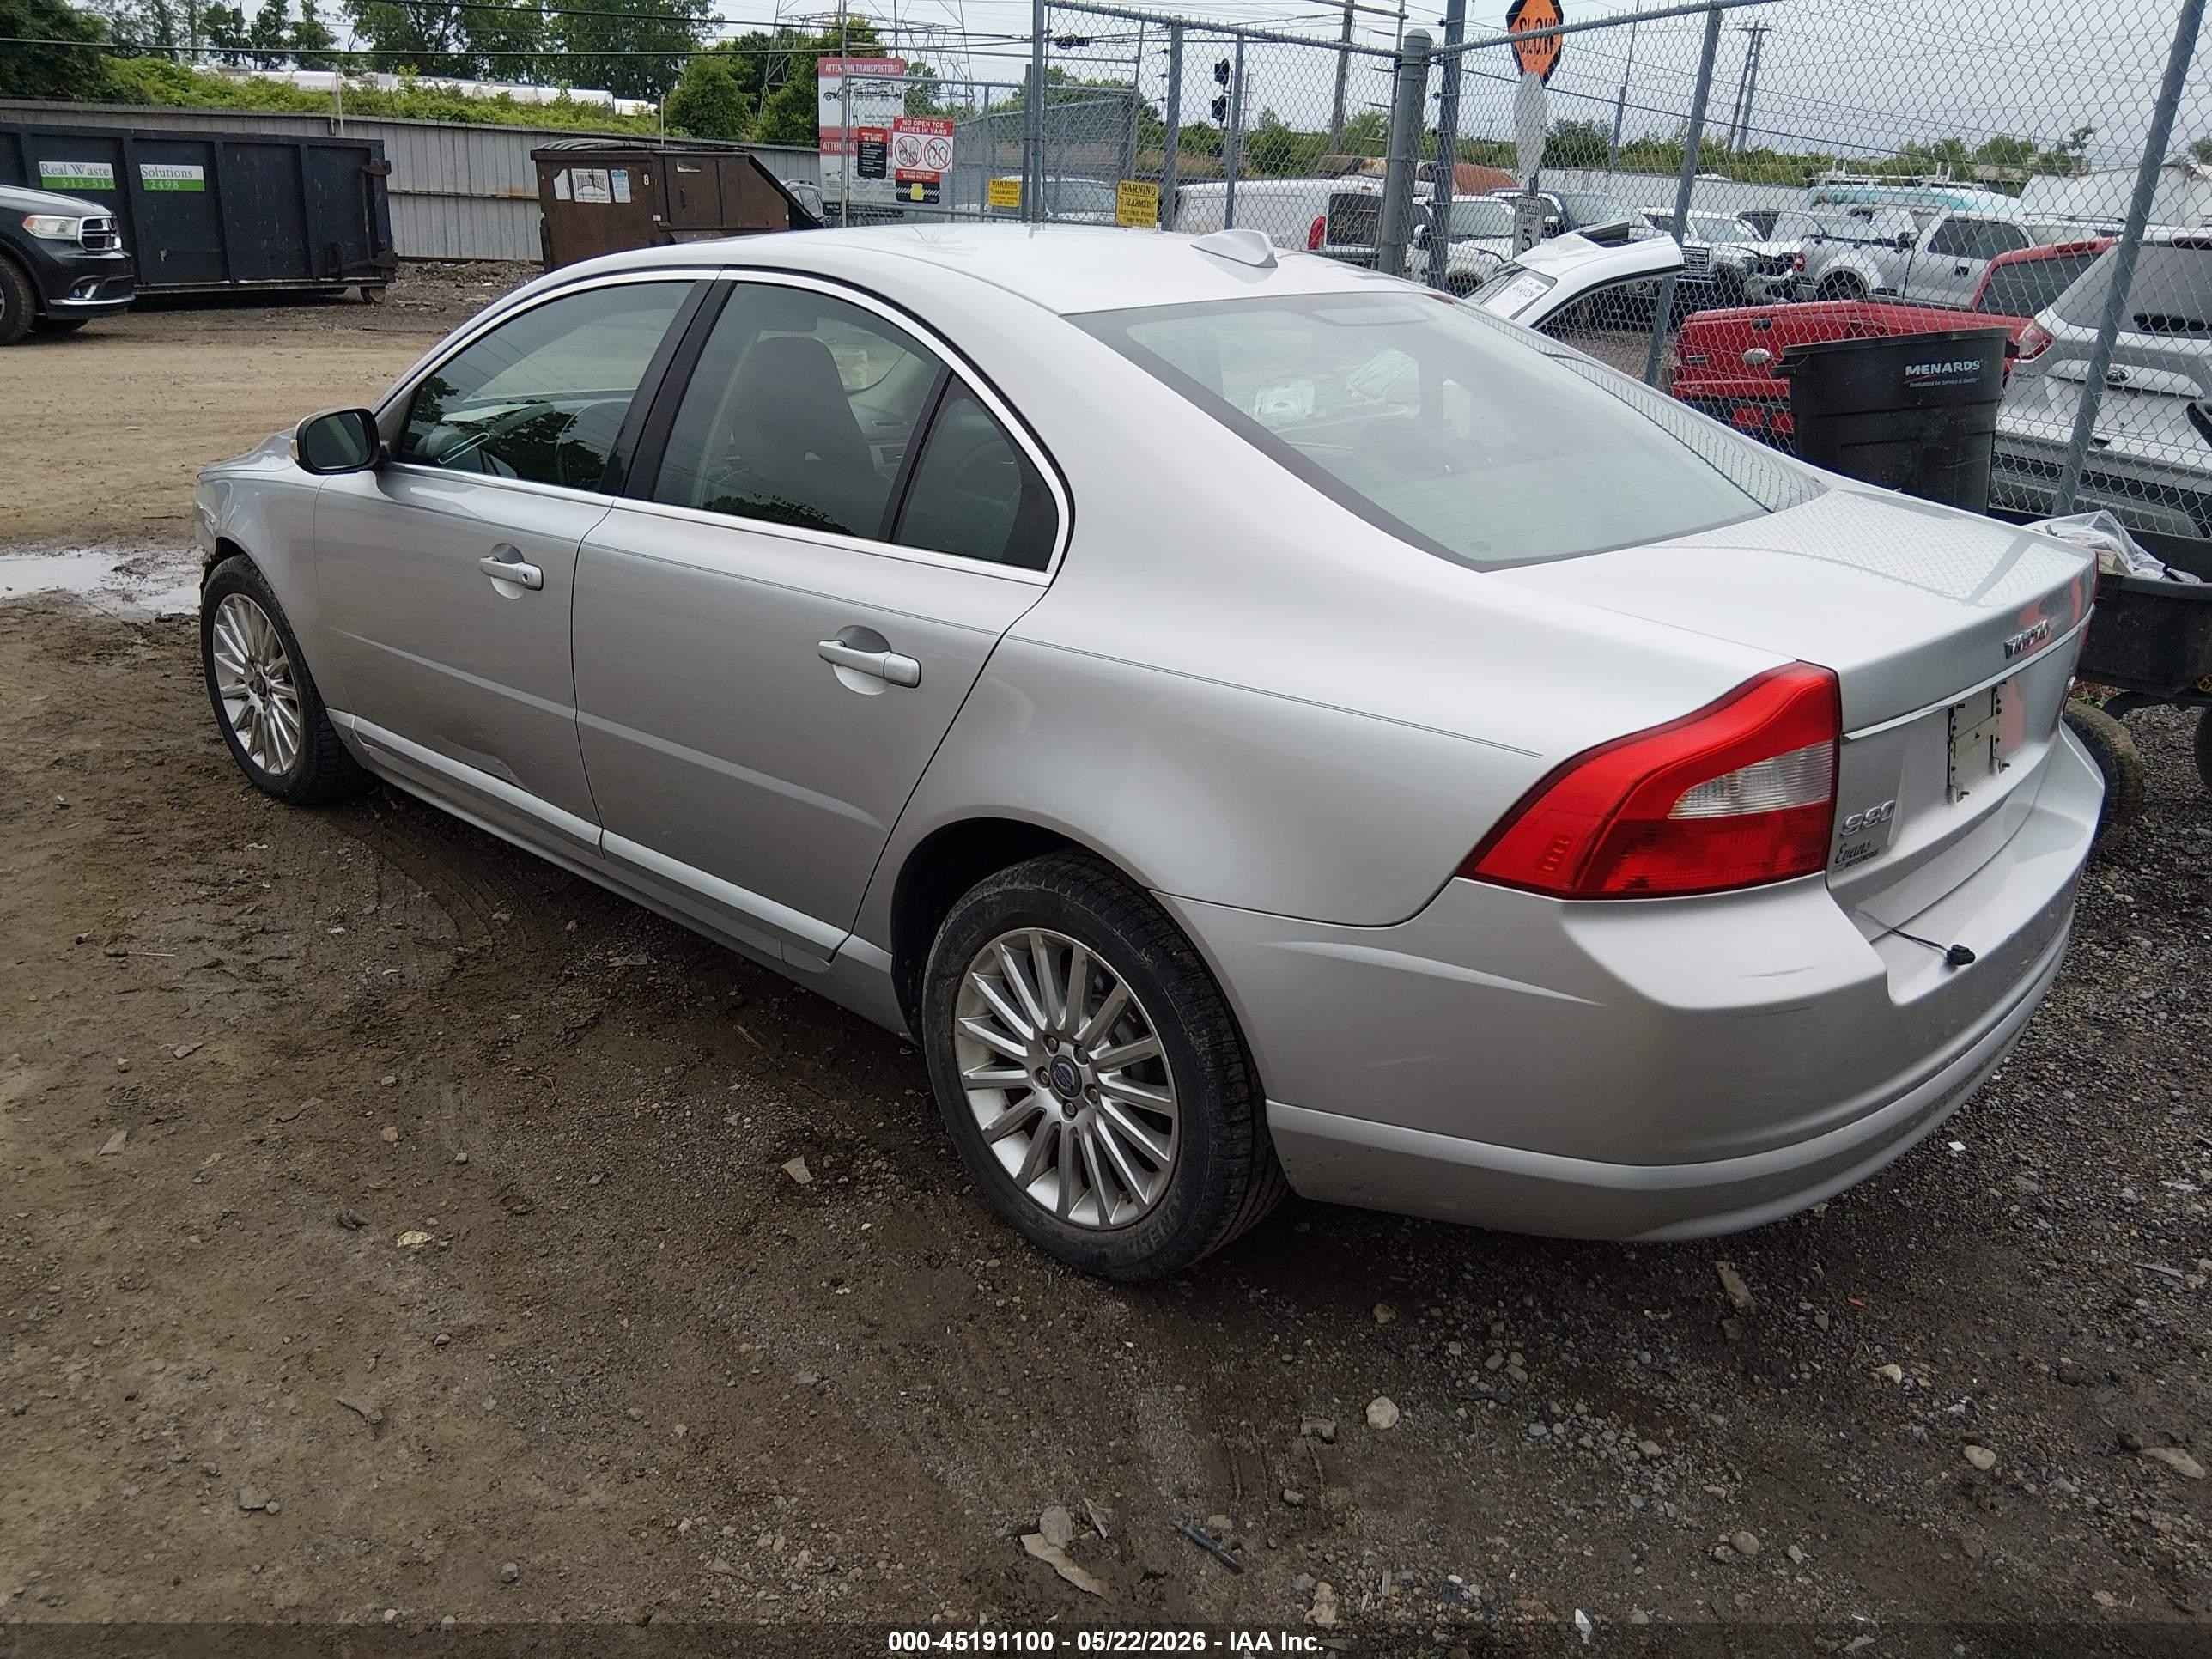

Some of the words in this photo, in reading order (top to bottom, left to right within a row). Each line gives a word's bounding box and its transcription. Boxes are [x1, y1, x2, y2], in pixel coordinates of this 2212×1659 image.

[1519, 17, 1556, 55] SLOW
[825, 64, 854, 73] ATTENION
[856, 64, 900, 73] TRANSPORTERS!
[40, 162, 68, 177] Real
[70, 164, 110, 177] Waste
[141, 166, 193, 179] Solutions
[62, 178, 114, 189] 513-512
[144, 180, 179, 190] -2498
[643, 174, 650, 186] 8
[1121, 182, 1156, 196] WARNING
[1124, 197, 1152, 208] ALARMED
[1518, 204, 1540, 216] SPEED
[1518, 216, 1538, 227] LIMIT
[1521, 228, 1533, 252] 5
[1905, 360, 1980, 376] MENARDS
[1835, 841, 1871, 864] Evans
